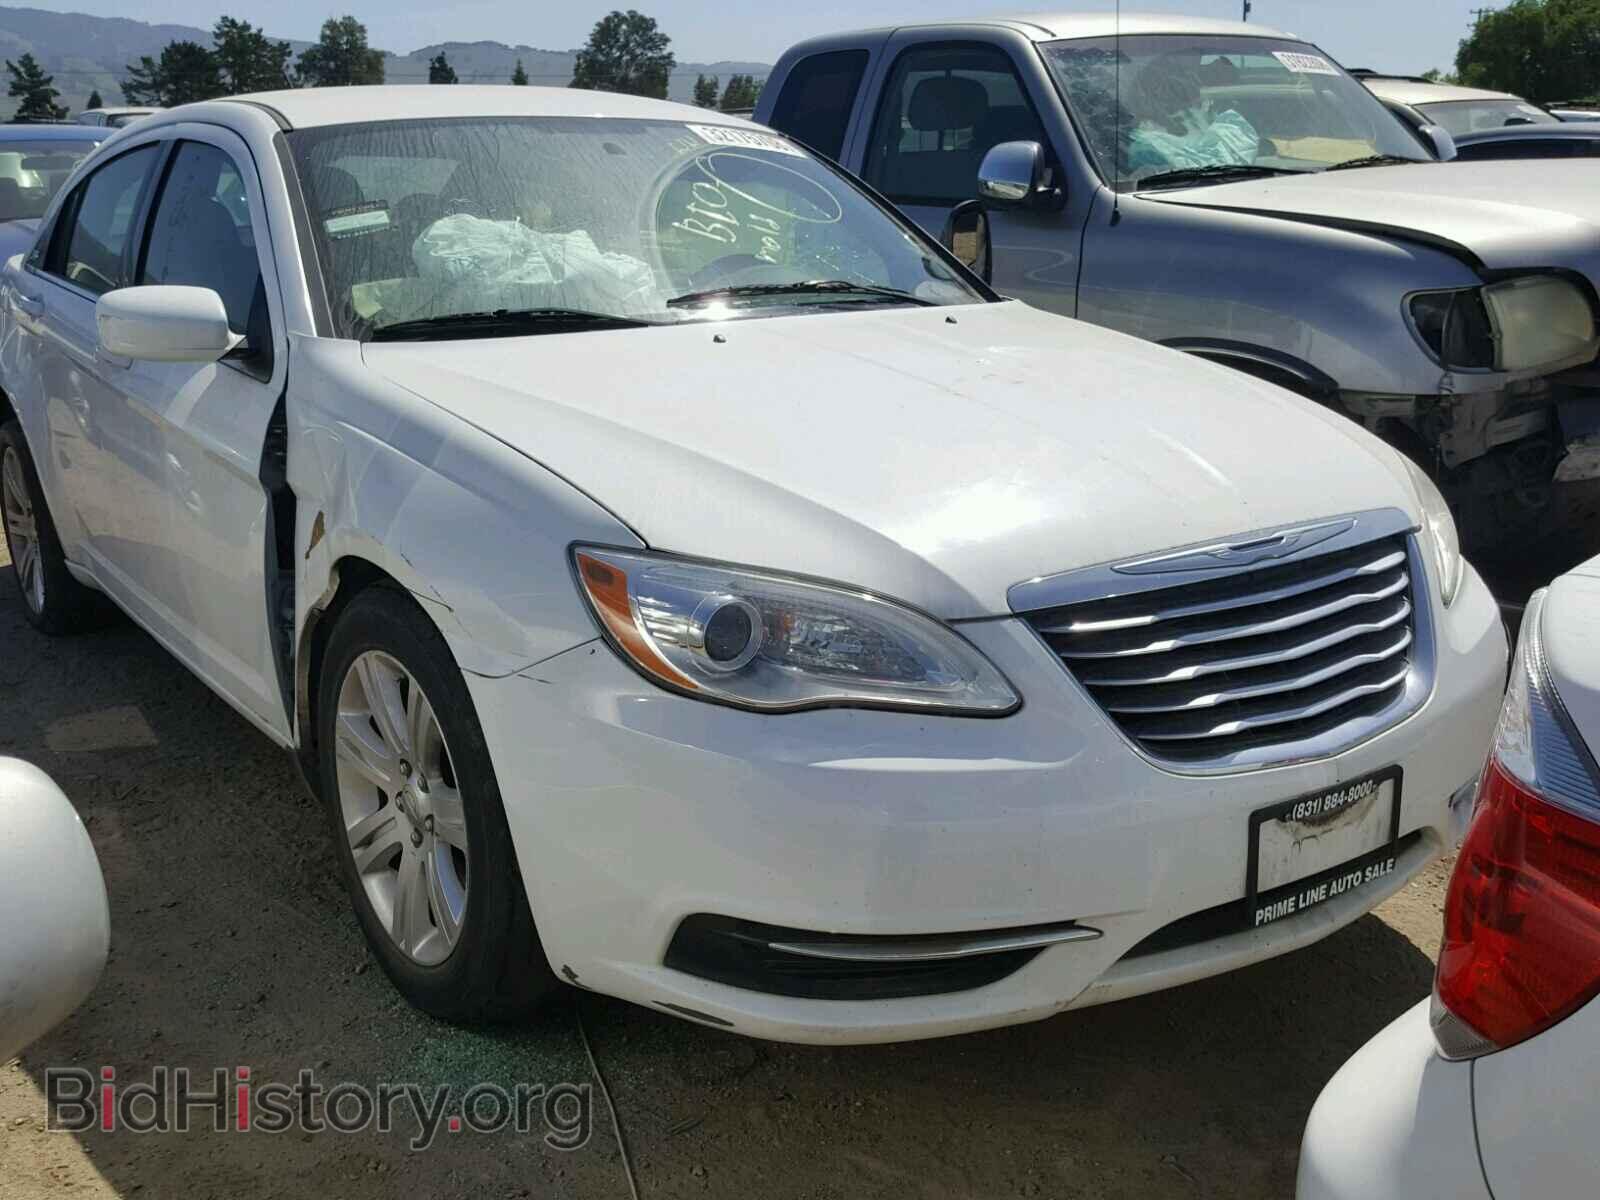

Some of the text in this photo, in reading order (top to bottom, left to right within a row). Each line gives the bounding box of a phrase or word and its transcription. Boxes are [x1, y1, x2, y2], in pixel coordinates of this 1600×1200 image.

[1292, 779, 1374, 820] (831) 884-8000
[1255, 858, 1395, 927] PRIME LINE AUTO SALE
